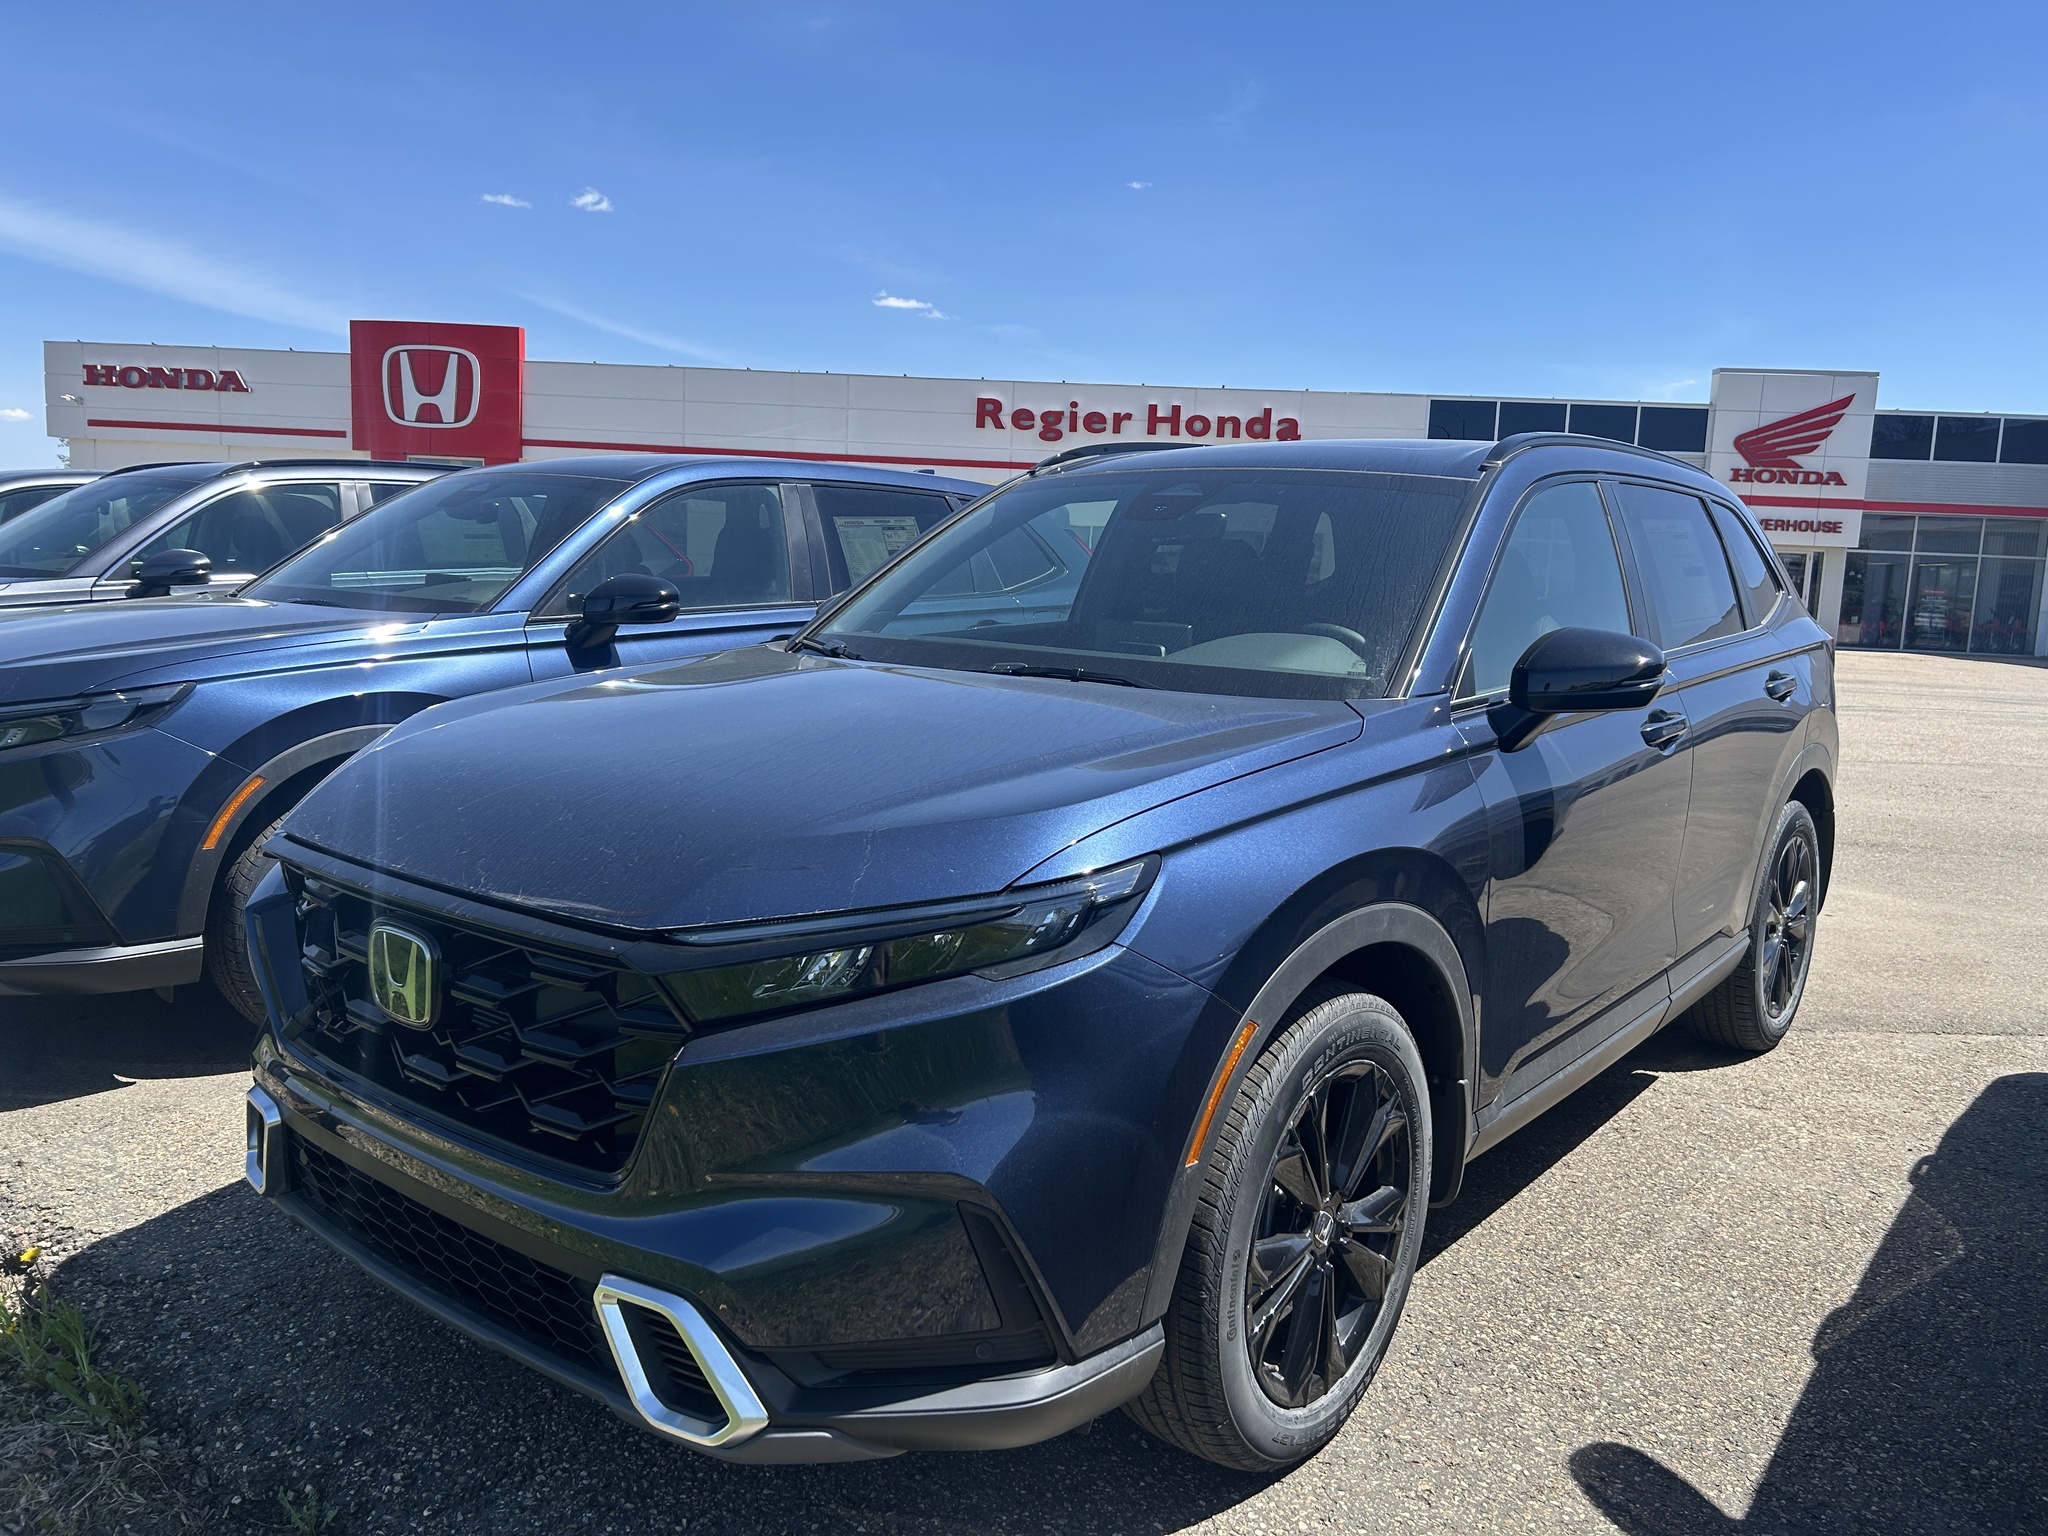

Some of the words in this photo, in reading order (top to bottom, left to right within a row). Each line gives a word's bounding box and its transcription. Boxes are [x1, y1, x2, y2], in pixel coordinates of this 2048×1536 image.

[82, 364, 252, 393] HONDA
[976, 397, 1132, 441] Regier
[1147, 404, 1301, 441] Honda
[1729, 468, 1847, 486] HONDA
[1302, 1026, 1401, 1091] CONTINENTAL
[1226, 1262, 1241, 1341] Continental
